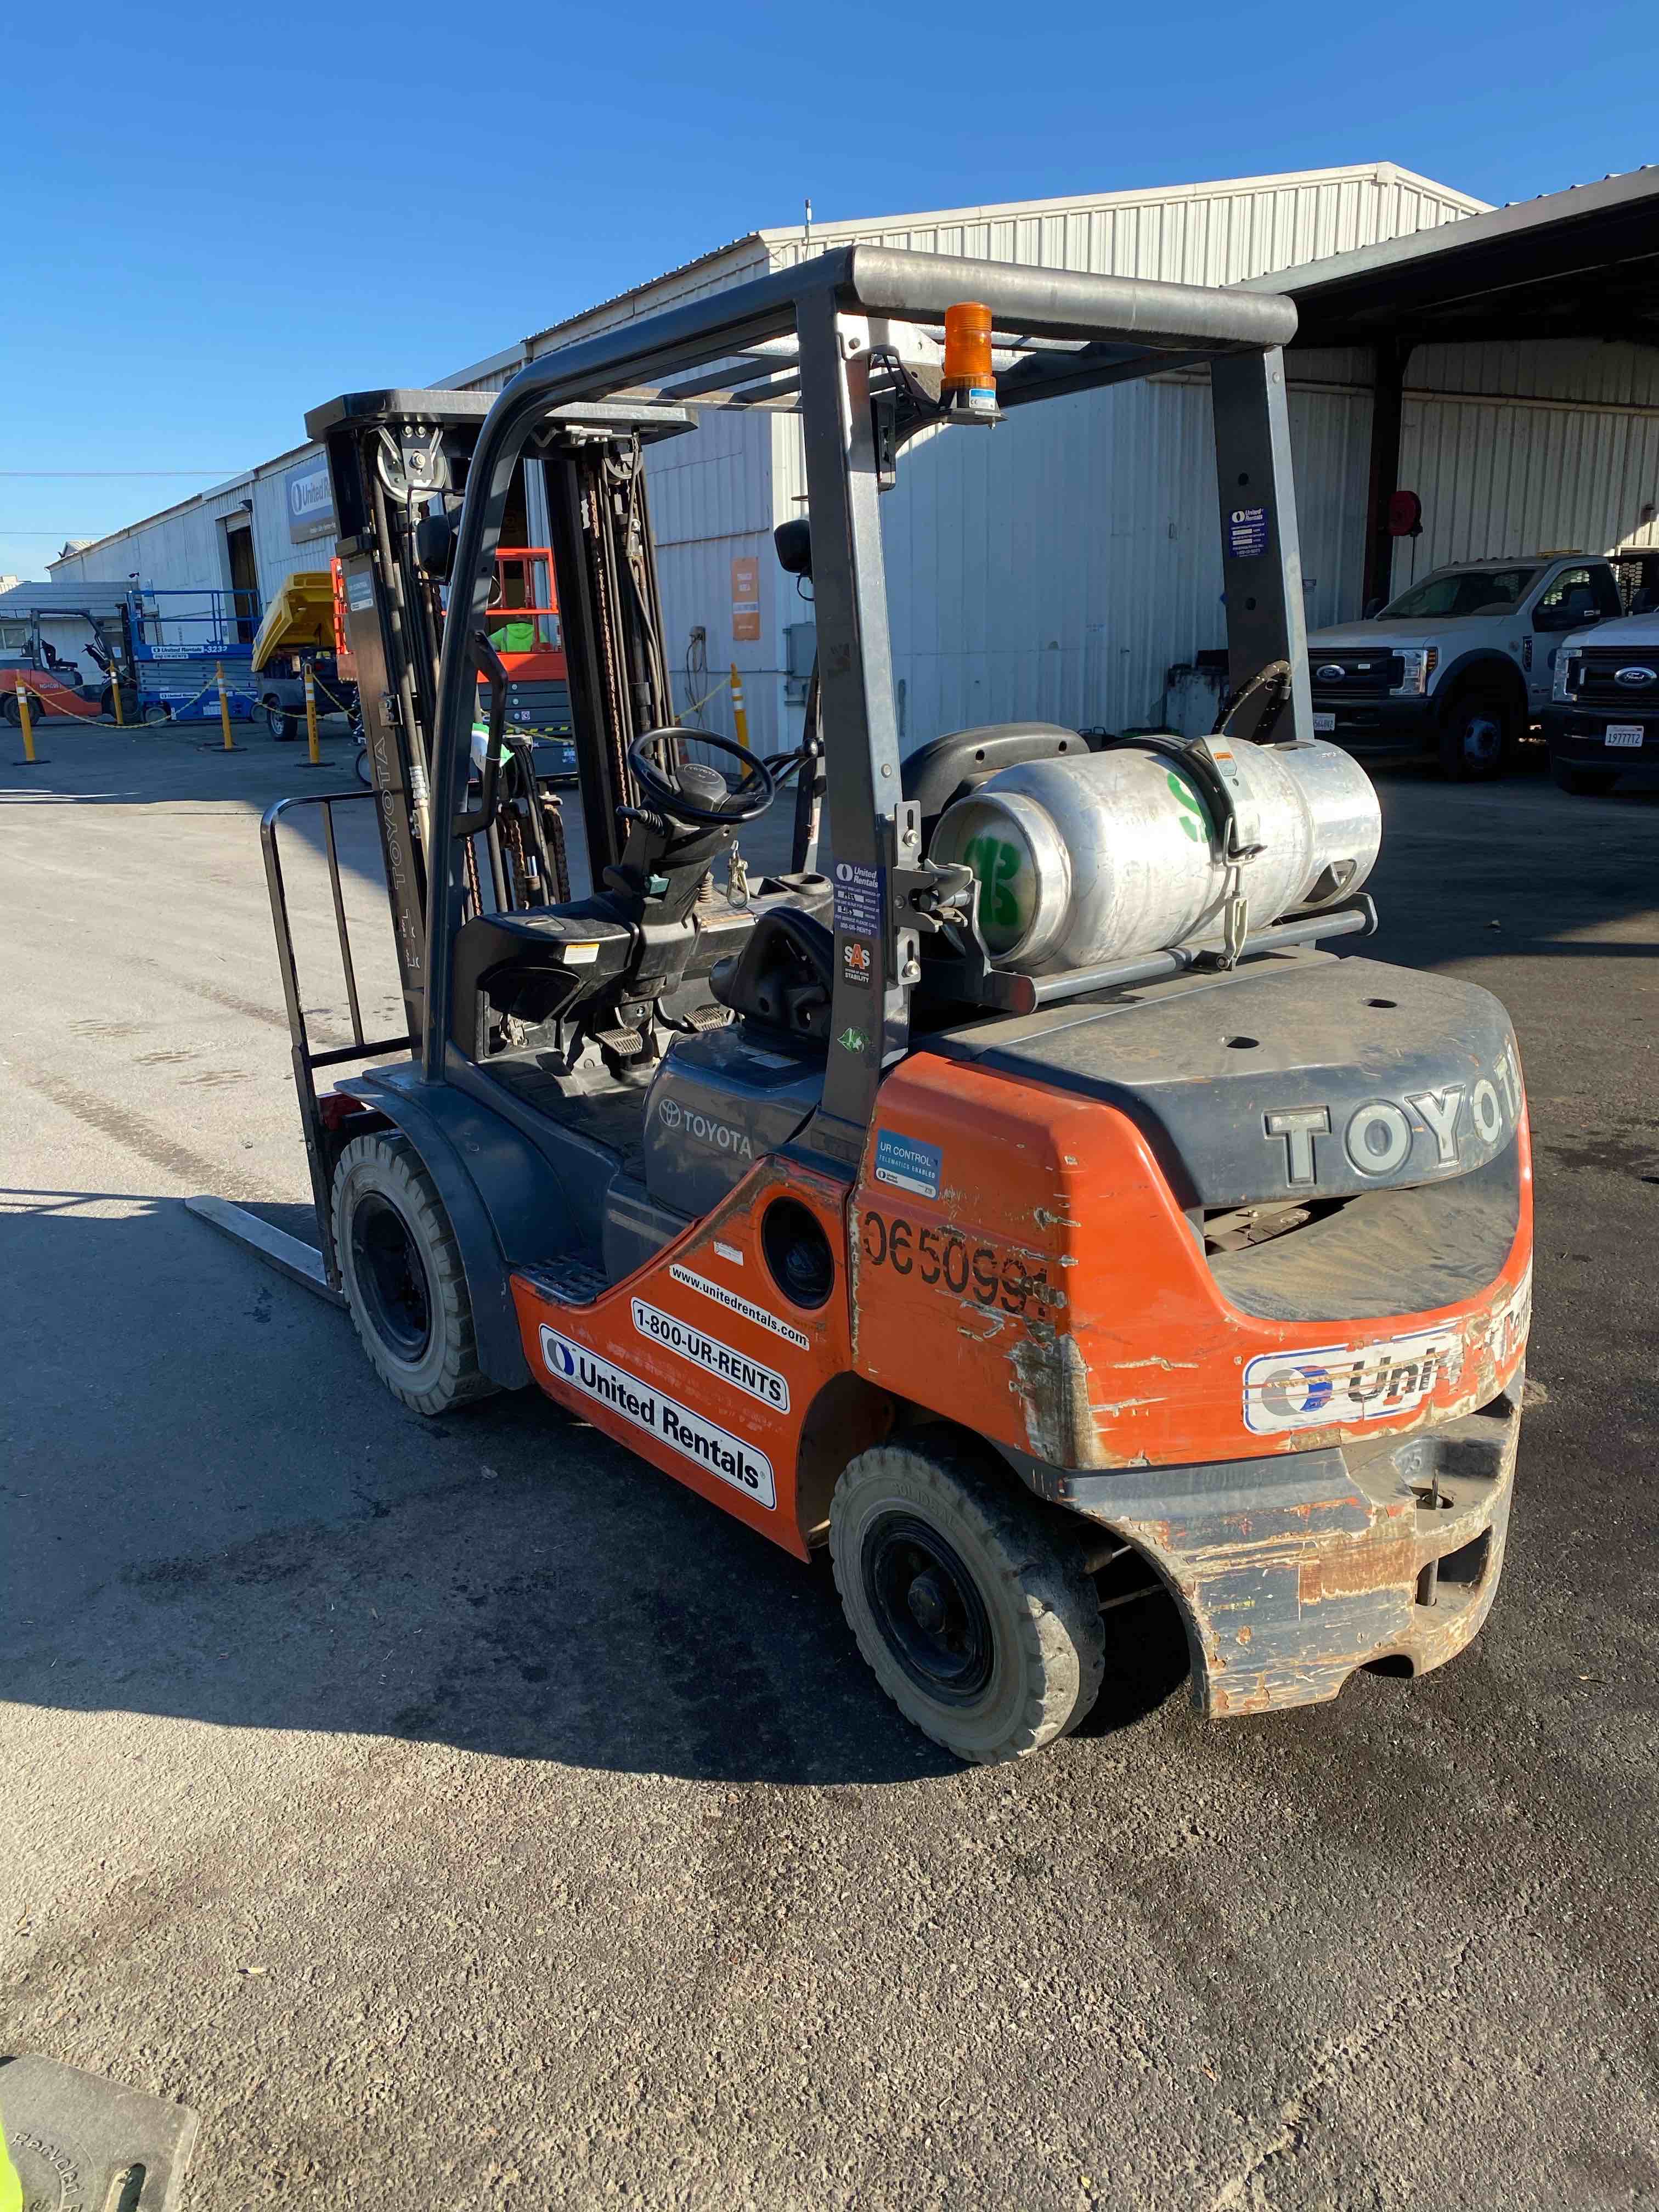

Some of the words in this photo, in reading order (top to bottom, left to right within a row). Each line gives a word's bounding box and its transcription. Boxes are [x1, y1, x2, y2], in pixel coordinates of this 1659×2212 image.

[374, 736, 405, 890] TOYOTA
[854, 866, 877, 878] United
[854, 876, 878, 888] Rentals
[844, 944, 870, 970] SAS
[845, 972, 869, 983] STABILITY
[684, 1110, 752, 1159] TOYOTA
[879, 1155, 910, 1169] TELEMATICS
[912, 1166, 935, 1178] ENABLED
[881, 1142, 891, 1153] UR
[893, 1147, 931, 1166] CONTROL
[672, 1267, 807, 1346] www.unitedrentals.com
[637, 1309, 781, 1401] 1-800-UR-RENTS
[580, 1357, 654, 1426] United
[663, 1406, 759, 1489] Rentals
[10, 2132, 84, 2195] Recycled
